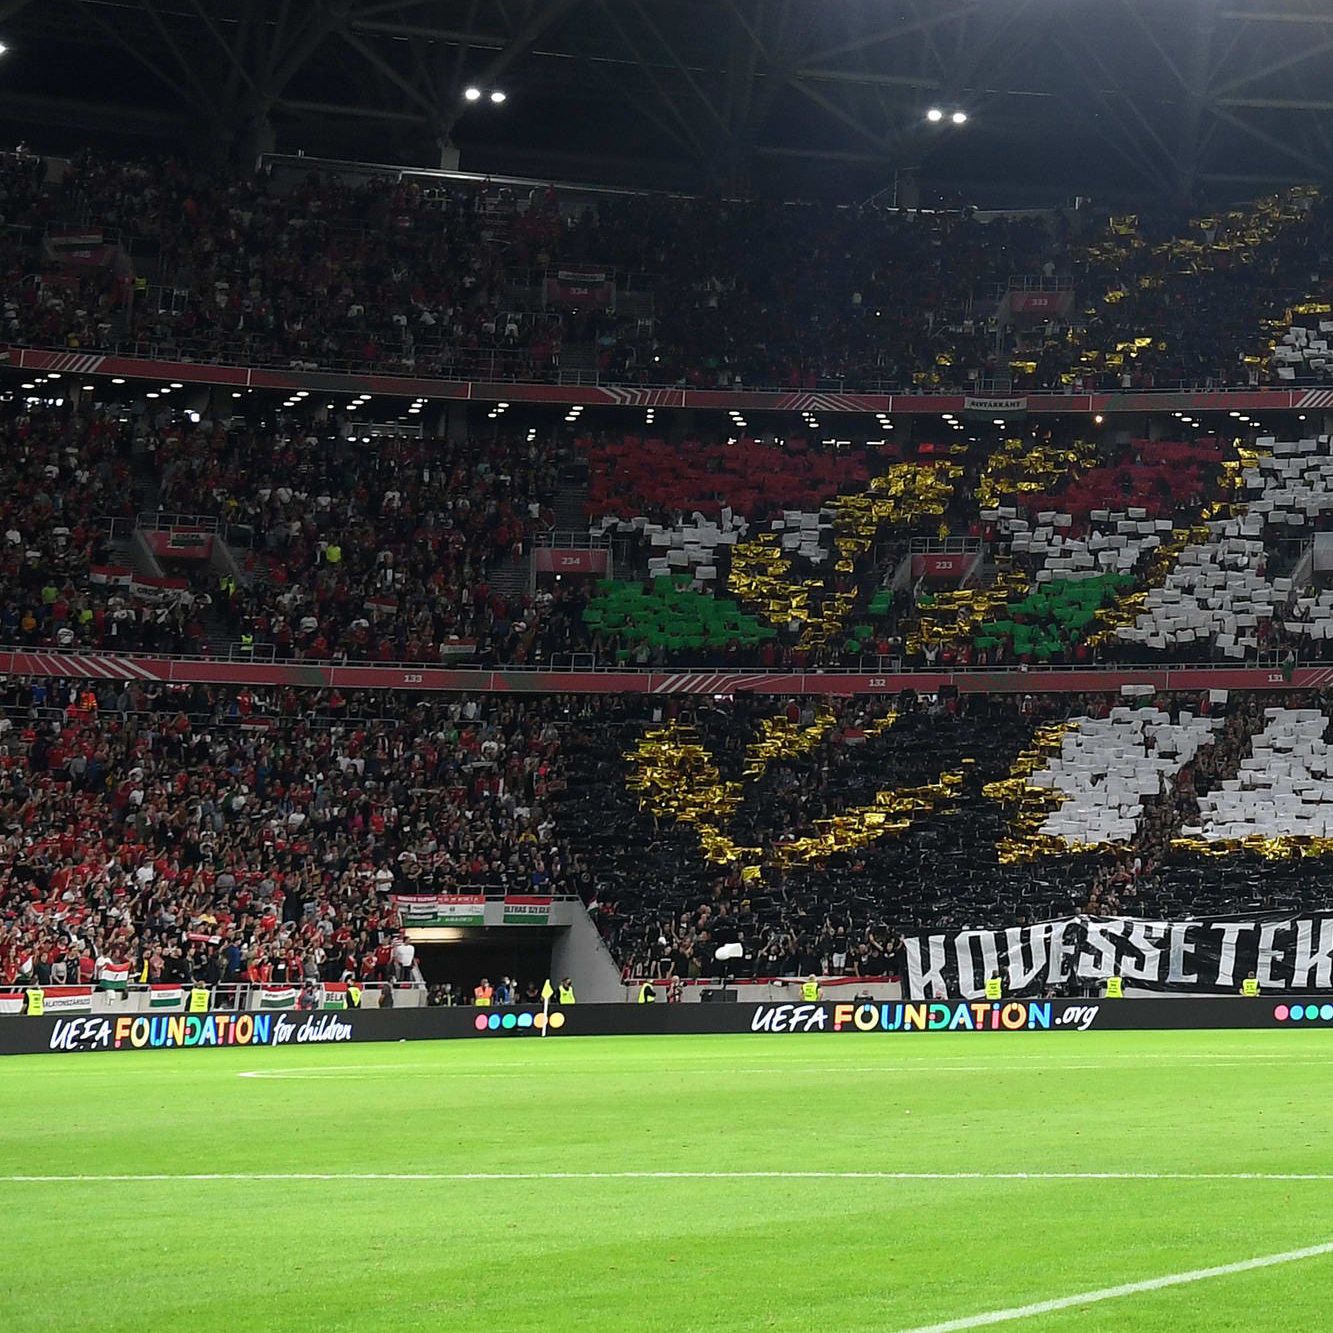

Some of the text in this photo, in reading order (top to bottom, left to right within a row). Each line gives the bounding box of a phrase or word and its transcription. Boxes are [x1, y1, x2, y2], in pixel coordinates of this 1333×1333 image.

[1031, 298, 1049, 307] 333
[561, 557, 580, 565] 234
[935, 561, 952, 570] 233
[404, 675, 422, 683] 133
[869, 679, 886, 687] 132
[1267, 674, 1284, 683] 131
[751, 1004, 828, 1032] UEFA
[50, 1013, 352, 1049] UEFA FOUNDATION for children
